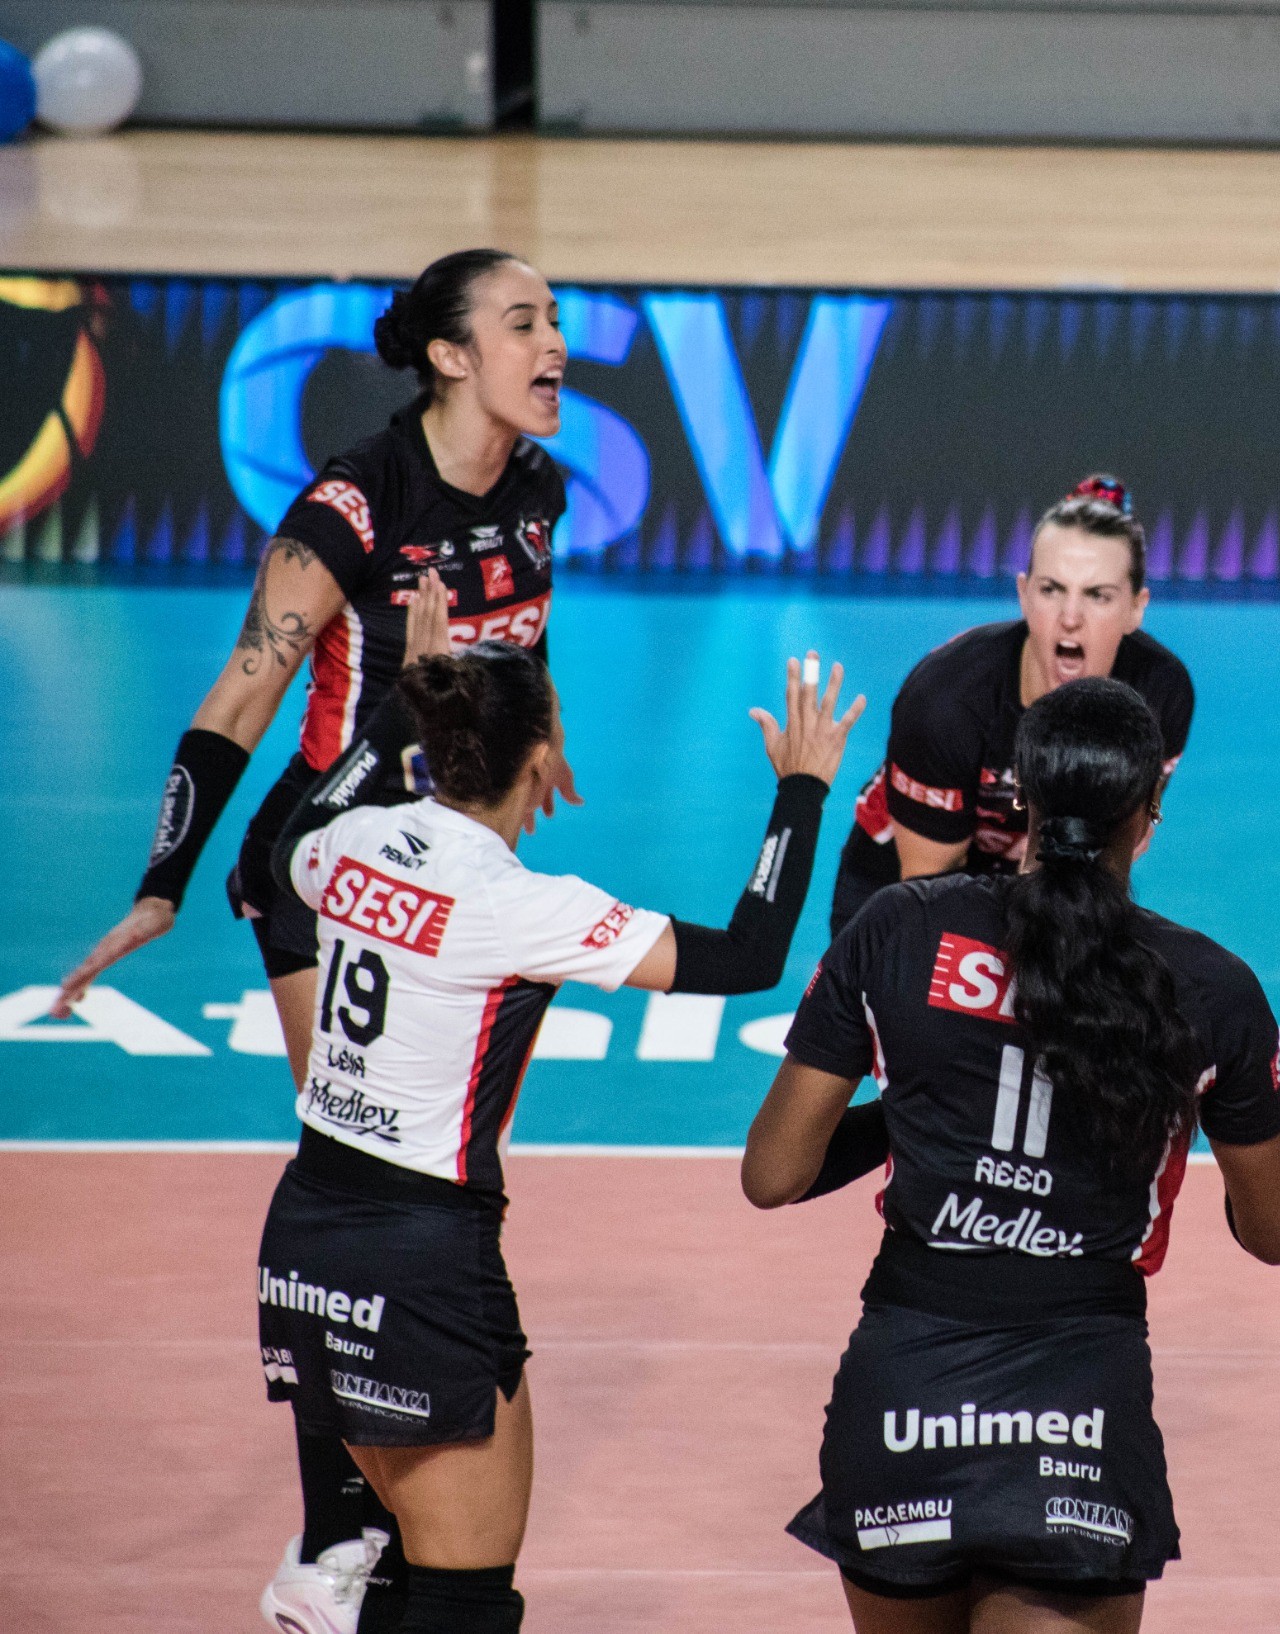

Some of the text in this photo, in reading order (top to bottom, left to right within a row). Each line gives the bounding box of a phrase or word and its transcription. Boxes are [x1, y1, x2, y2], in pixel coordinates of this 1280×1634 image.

[326, 868, 439, 946] SESI
[320, 938, 391, 1048] 19
[990, 1044, 1054, 1159] 11
[974, 1155, 1053, 1197] REED
[257, 1266, 385, 1334] Unimed
[325, 1331, 374, 1361] Bauru
[883, 1403, 1105, 1453] Unimed
[1039, 1456, 1101, 1482] Bauru
[854, 1499, 953, 1527] PACAEMBU
